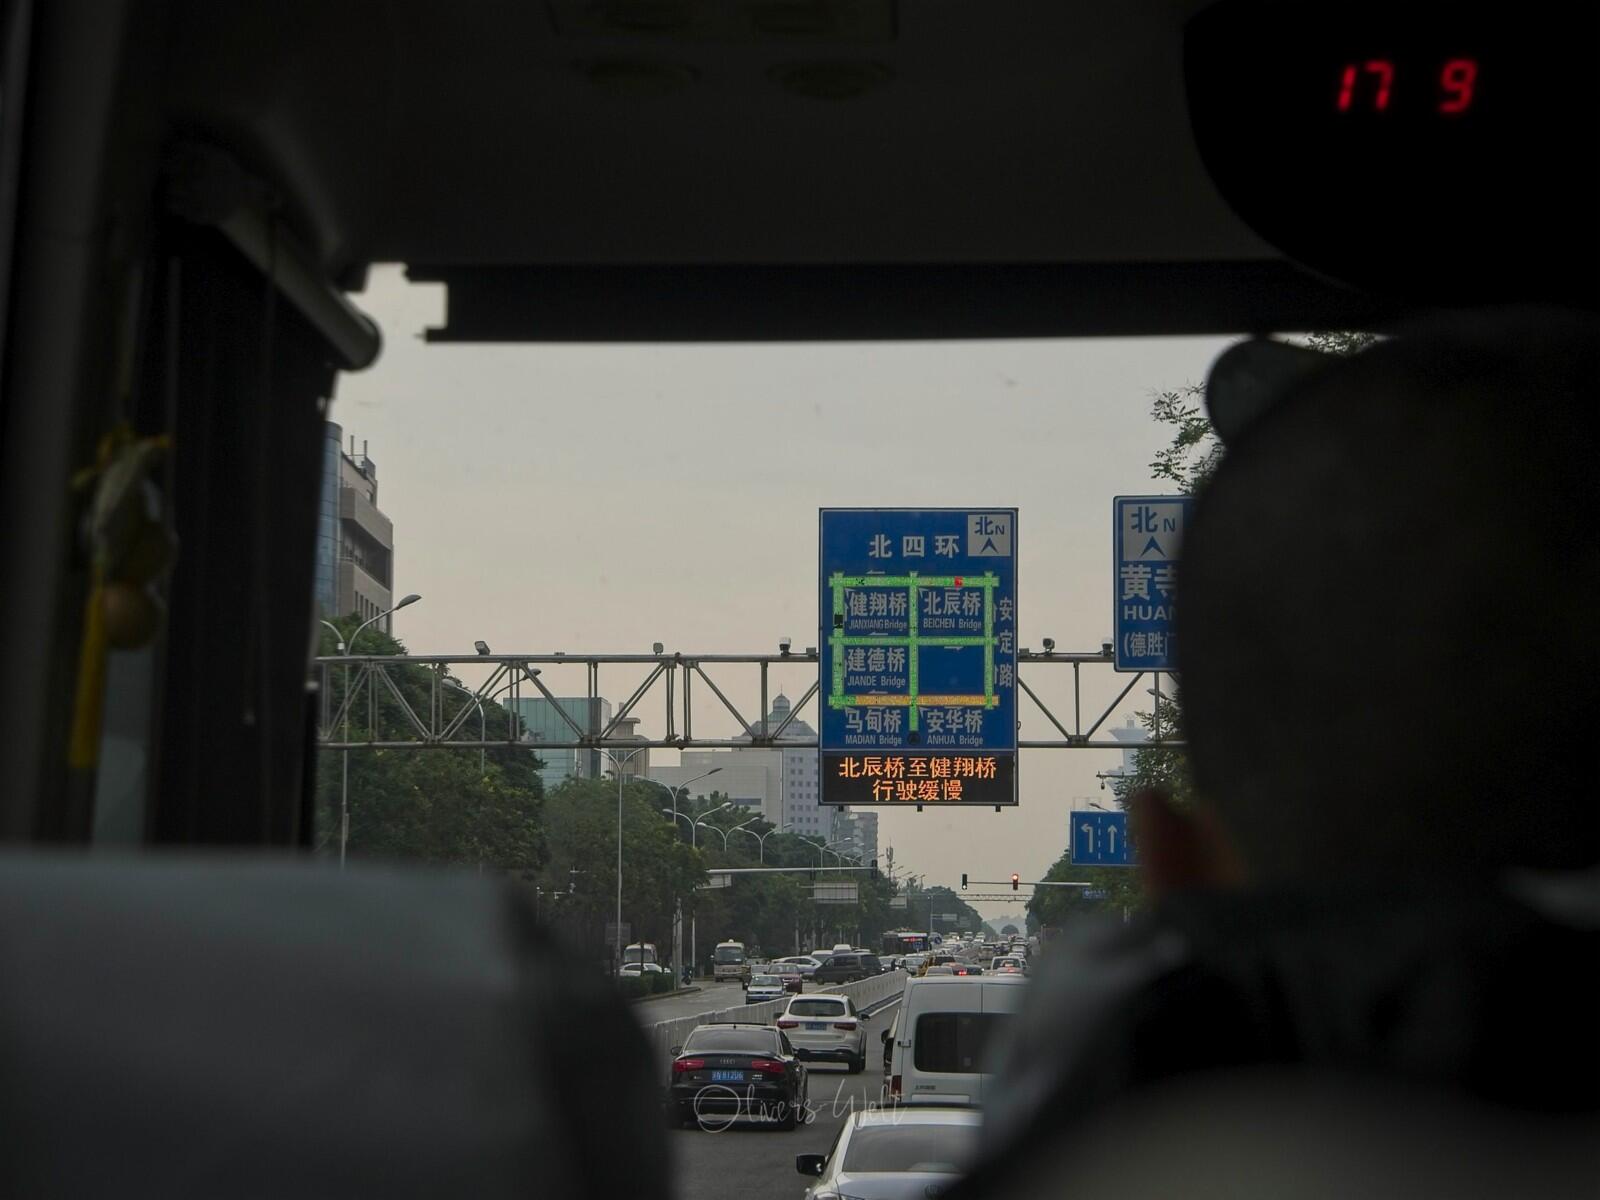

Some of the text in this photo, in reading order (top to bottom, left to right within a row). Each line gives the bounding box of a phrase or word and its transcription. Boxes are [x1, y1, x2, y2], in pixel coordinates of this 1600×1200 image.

[1338, 59, 1477, 113] 17 9
[868, 534, 960, 558] 北四环
[850, 592, 907, 616] 健翔桥
[923, 591, 981, 616] 北辰桥
[849, 619, 908, 631] JIANXIANG Bridge
[923, 618, 982, 631] BEICHEN Bridge
[1000, 596, 1013, 688] 安定路
[848, 648, 905, 673] 建德桥
[847, 675, 906, 688] JIANDE Bridge
[845, 709, 902, 733] 马甸桥
[926, 709, 983, 733] 安华桥
[845, 735, 902, 746] MADIAN Bridge
[926, 735, 983, 747] ANHUA Bridge
[838, 757, 997, 779] 北辰桥至健翔桥
[872, 779, 963, 801] 行驶缓慢
